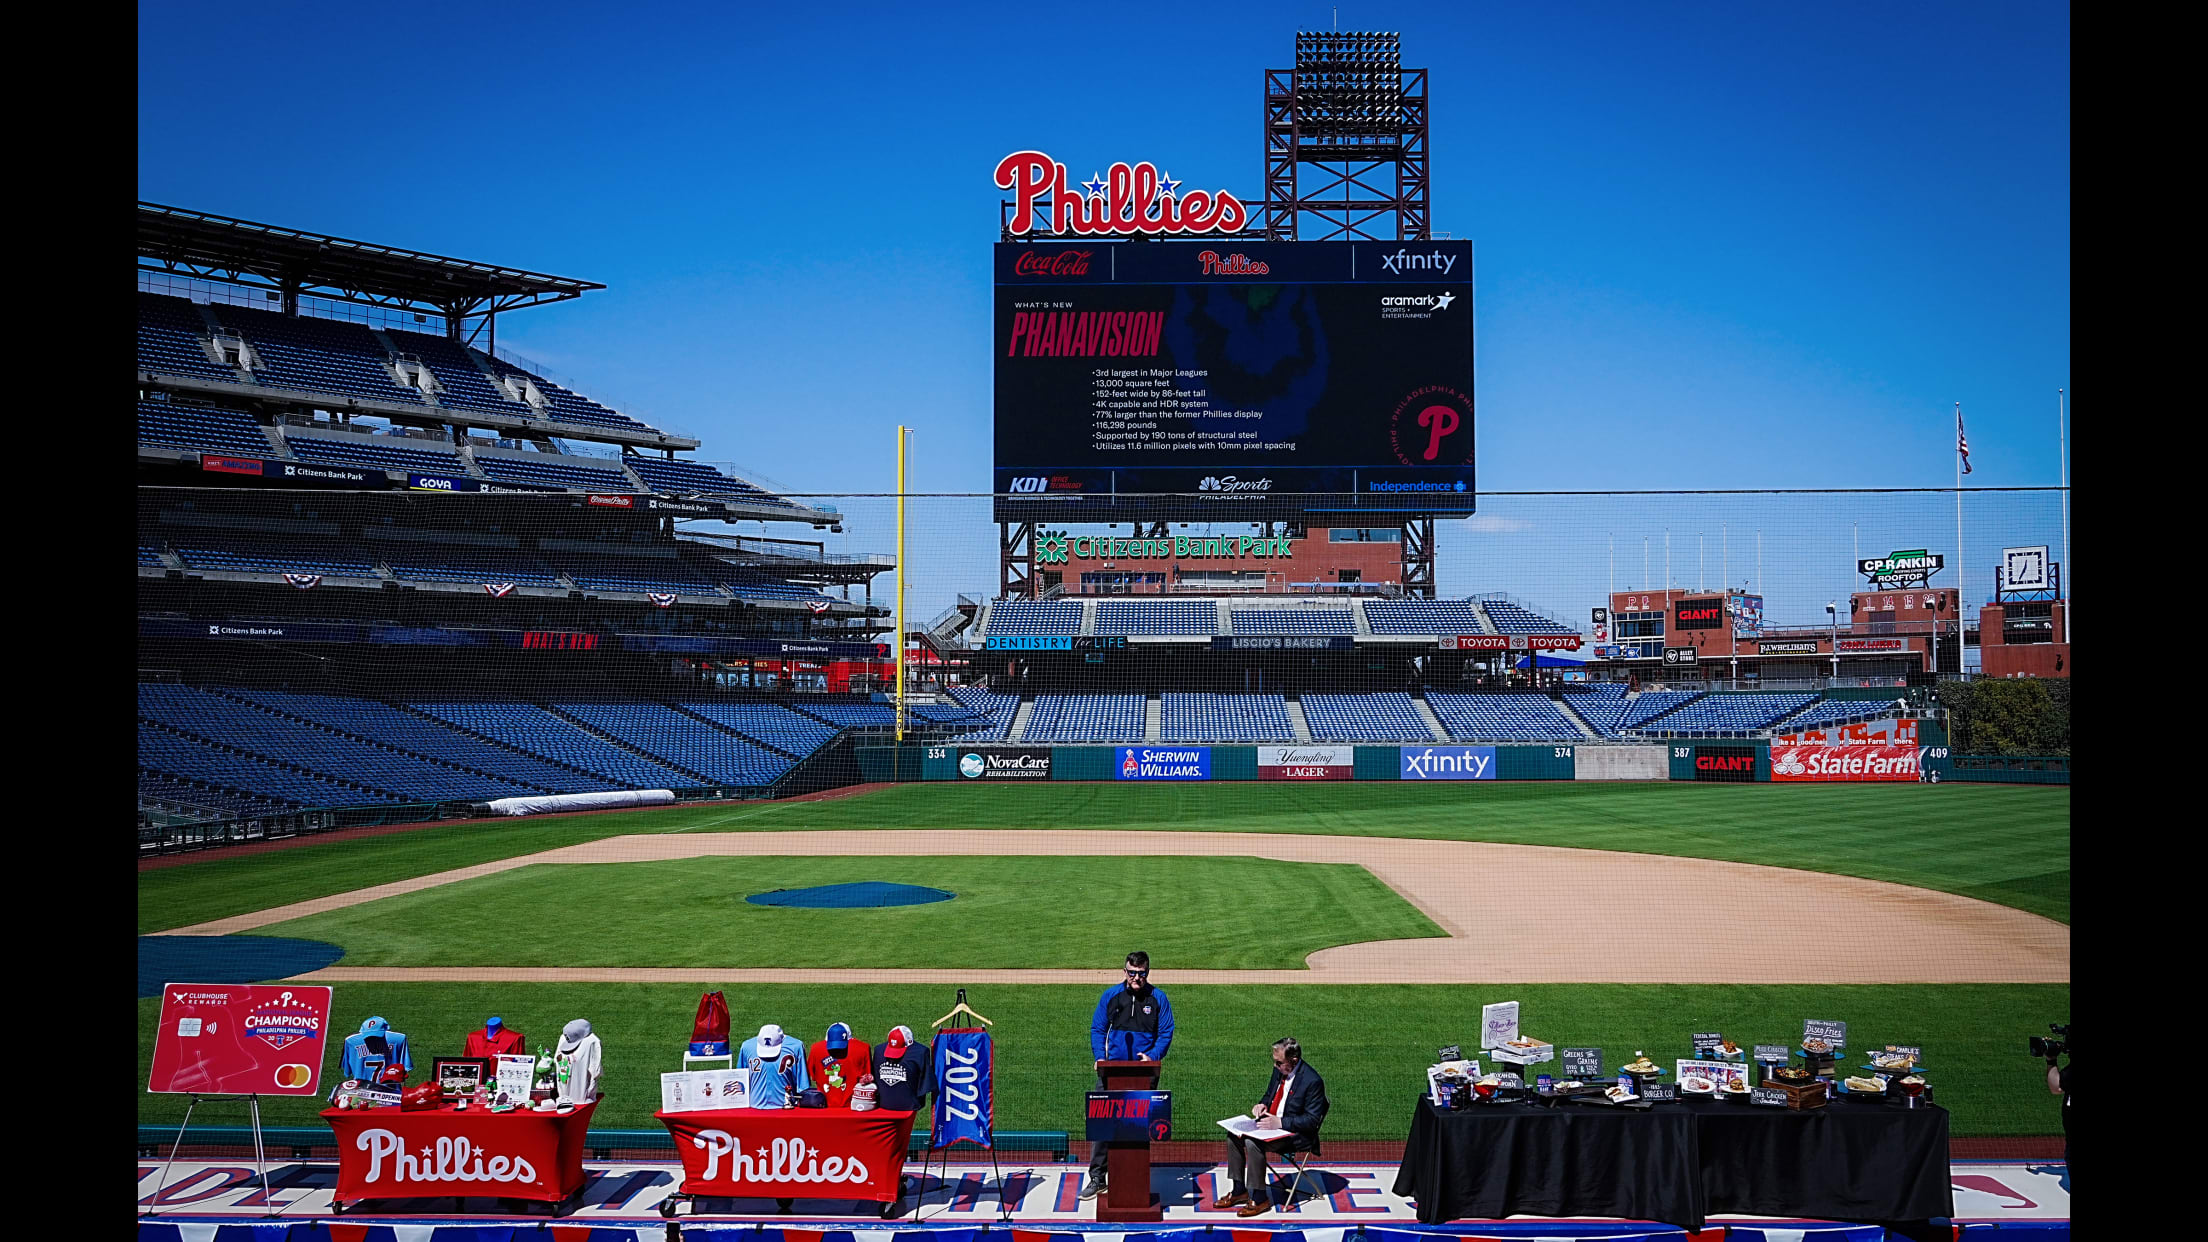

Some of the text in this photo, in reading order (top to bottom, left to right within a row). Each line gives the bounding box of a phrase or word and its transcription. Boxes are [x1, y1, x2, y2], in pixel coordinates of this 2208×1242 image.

[994, 150, 1247, 236] Phillies
[1199, 250, 1269, 275] Phillies
[1382, 249, 1457, 275] xfinity
[1381, 294, 1435, 306] aramark
[1008, 312, 1164, 357] PHANAVISION
[1096, 369, 1208, 378] 3rd largest in Major Leagues
[1096, 379, 1170, 389] 13,000 square feet
[1096, 389, 1128, 398] 152-feet
[1130, 390, 1149, 398] wide
[1150, 390, 1161, 399] by
[1162, 389, 1191, 397] 86-feet
[1096, 400, 1209, 410] 4K capable and HDR system
[1096, 411, 1113, 419] 77%
[1114, 411, 1137, 420] larger
[1139, 411, 1158, 419] than
[1203, 410, 1233, 418] Phillies
[1234, 410, 1263, 420] display
[1096, 421, 1157, 431] 116,298 pounds
[1096, 431, 1258, 441] Supported by 190 tons of structural steel
[1418, 405, 1460, 461] P
[1096, 442, 1296, 452] Utilizes 11.6 million pixels with 10mm pixel spacing
[297, 468, 364, 481] Citizens Bank Park
[419, 478, 452, 490] GOYA
[1009, 477, 1049, 493] KDI
[1220, 475, 1273, 493] Sports
[1370, 480, 1452, 494] Independence
[1073, 534, 1293, 557] Citizens Bank Park
[1864, 556, 1937, 571] CP RANKIN
[1877, 573, 1923, 582] ROOFTOP
[1882, 595, 1894, 606] 14
[1903, 594, 1914, 606] 15
[1678, 608, 1719, 620] GIANT
[221, 627, 249, 635] Citizens
[523, 631, 599, 650] WHAT'S NEW!
[987, 636, 1124, 649] DENTISTRY for LIFE
[1232, 637, 1331, 648] LISCIO'S BAKERY
[1460, 637, 1506, 648] TOYOTA
[1531, 637, 1577, 648] TOYOTA
[928, 748, 946, 759] 334
[1141, 750, 1200, 763] SHERWIN
[1275, 748, 1336, 765] Yuengling
[1554, 748, 1571, 758] 374
[1674, 748, 1690, 758] 387
[1930, 748, 1948, 758] 409
[985, 755, 1049, 769] NovaCare
[1406, 748, 1490, 778] xfinity
[1696, 756, 1755, 771] GIANT
[1286, 767, 1325, 777] LAGER
[281, 991, 293, 1007] P
[245, 1015, 319, 1030] CHAMPIONS
[364, 1059, 386, 1083] 7
[749, 1058, 761, 1072] 12
[779, 1054, 795, 1075] P
[945, 1048, 979, 1121] 2022
[1088, 1099, 1150, 1118] WHAT'S NEW!
[1156, 1123, 1168, 1140] P
[356, 1128, 536, 1184] Phillies
[694, 1129, 870, 1184] Phillies
